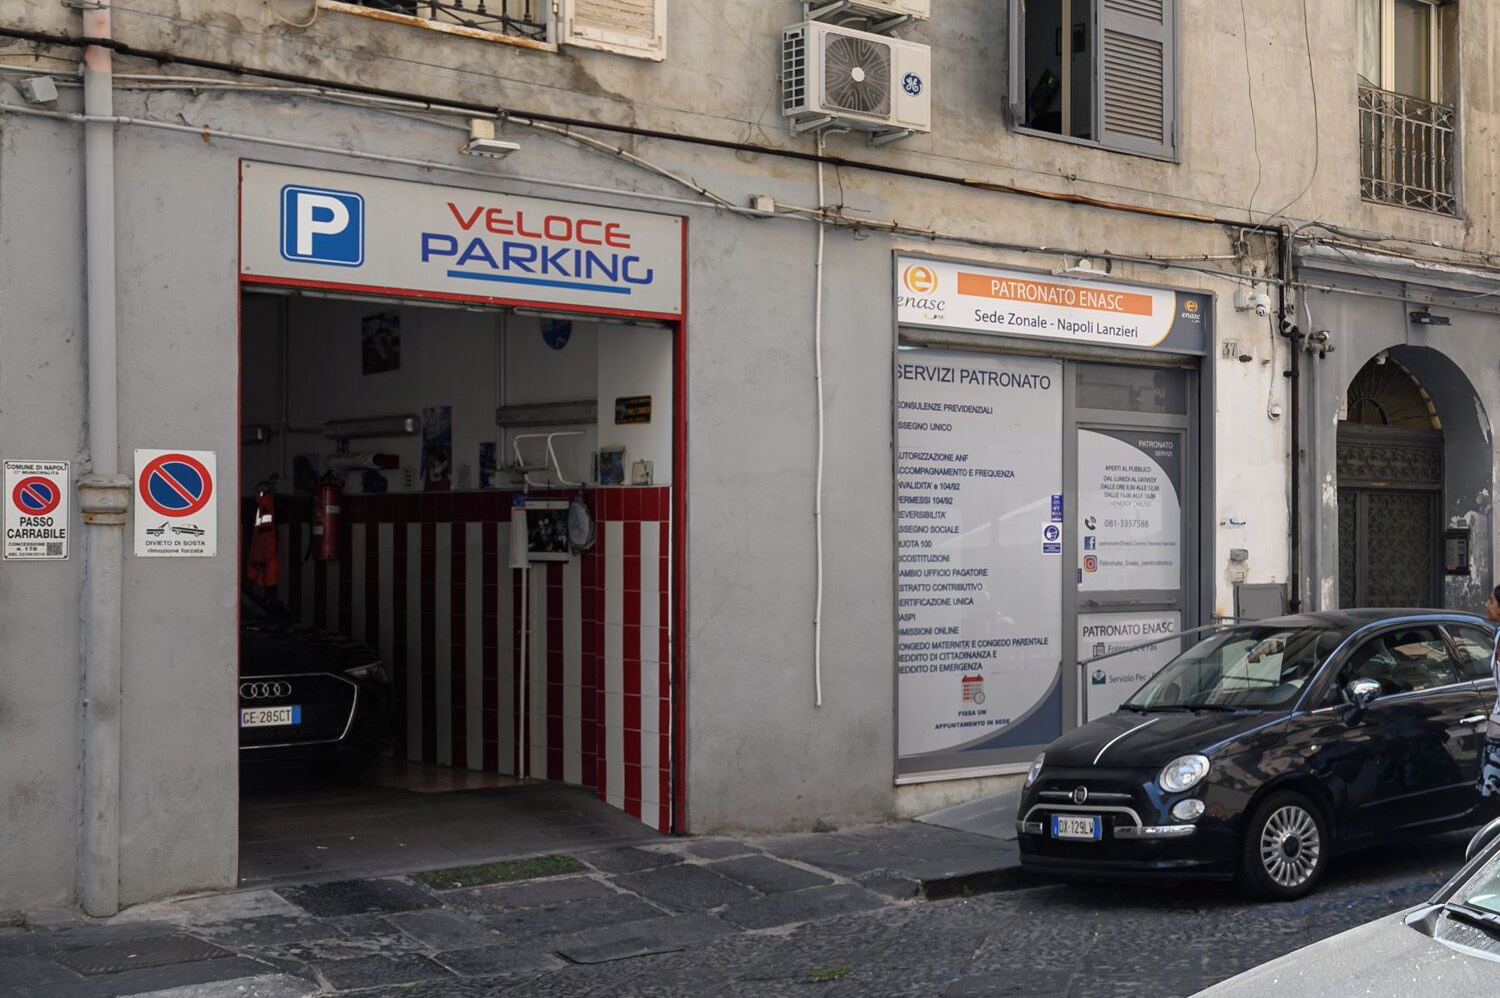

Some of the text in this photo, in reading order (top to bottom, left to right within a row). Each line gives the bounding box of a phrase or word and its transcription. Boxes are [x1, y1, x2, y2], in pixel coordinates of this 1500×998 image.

[297, 192, 350, 255] P
[446, 202, 631, 249] VELOCE
[421, 232, 653, 285] PARKING
[991, 280, 1124, 312] PATRONATO ENASC
[897, 296, 946, 311] enasc
[974, 309, 1004, 324] Sede
[1008, 313, 1047, 329] Zonale
[1058, 318, 1094, 335] Napoli
[1097, 322, 1138, 338] Lanzieri
[960, 369, 1051, 390] PATRONATO
[944, 404, 993, 414] PREVIDENZIALI
[898, 422, 952, 432] SSEGNO UNICO
[1138, 440, 1173, 449] PATRONATO
[898, 452, 969, 462] UTORIZZAZIONE ANF
[898, 467, 968, 476] CCOMPAGNAMENTO
[975, 469, 1015, 478] FREQUENZA
[940, 482, 960, 490] 104/92
[20, 517, 54, 527] PASSO
[7, 529, 66, 539] CARRABILE
[898, 525, 960, 534] SSEGNO SOCIALE
[921, 540, 932, 548] 100
[924, 569, 950, 577] UFFICIO
[952, 568, 988, 577] PAGATORE
[898, 583, 983, 592] STRATTO CONTRIBUTIVO
[953, 597, 974, 606] UNICA
[934, 626, 960, 634] ONLINE
[1083, 622, 1174, 637] PATRONATO ENASC
[972, 640, 976, 648] E
[978, 639, 1011, 648] CONGEDO
[1012, 637, 1049, 646] PARENTALE
[930, 653, 938, 661] DI
[939, 651, 991, 661] CITTADINANZA
[993, 650, 997, 658] E
[930, 664, 938, 672] DI
[939, 663, 983, 672] EMERGENZA
[1108, 674, 1134, 683] Servizio
[934, 720, 986, 730] APPUNTAMENTO
